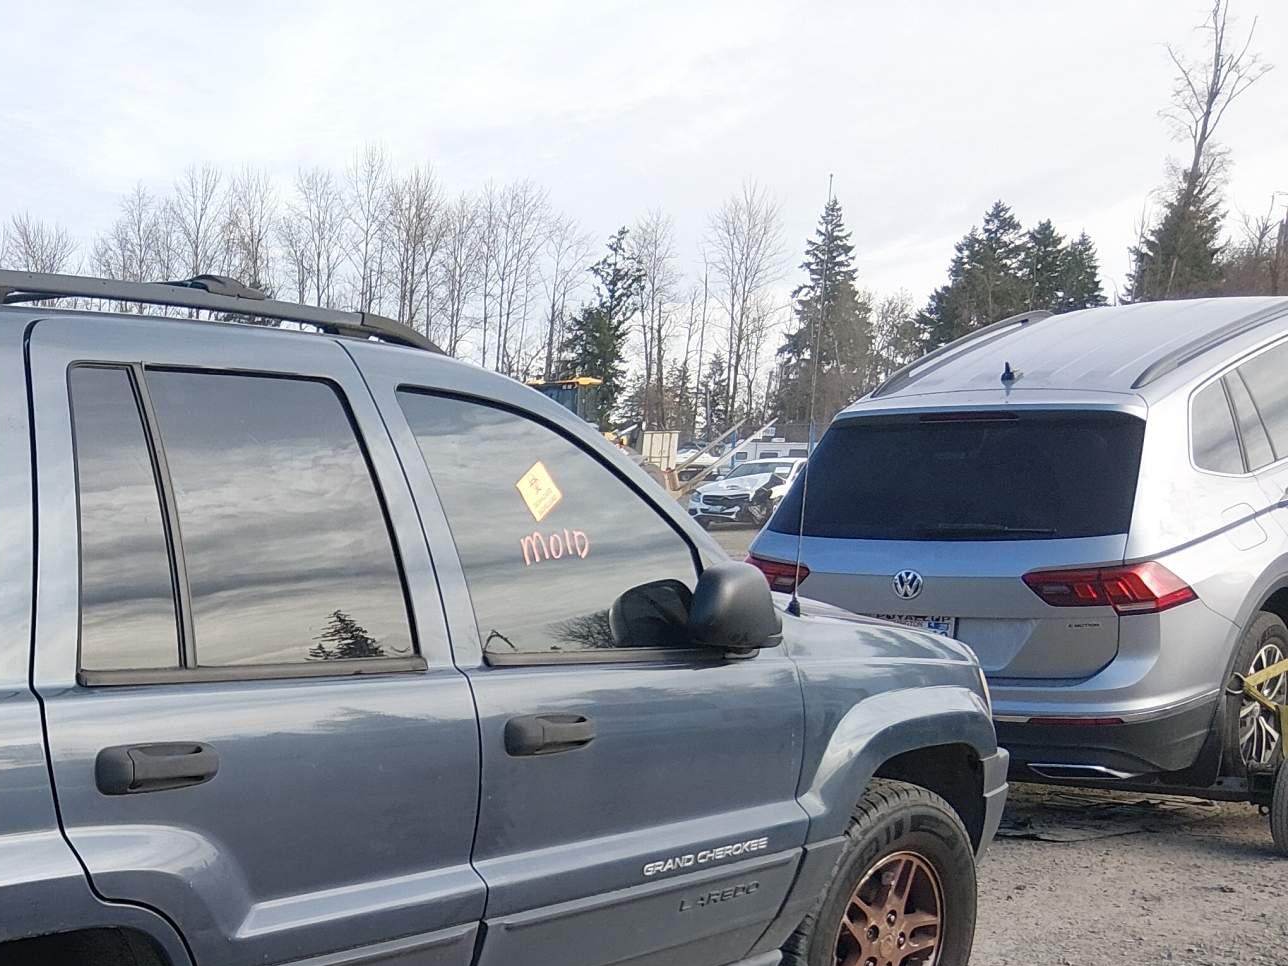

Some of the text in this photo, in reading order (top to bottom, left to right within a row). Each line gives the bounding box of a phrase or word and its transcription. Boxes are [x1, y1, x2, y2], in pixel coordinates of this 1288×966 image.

[643, 837, 769, 876] GRAND CHEROKEE
[678, 880, 760, 912] LAREDO
